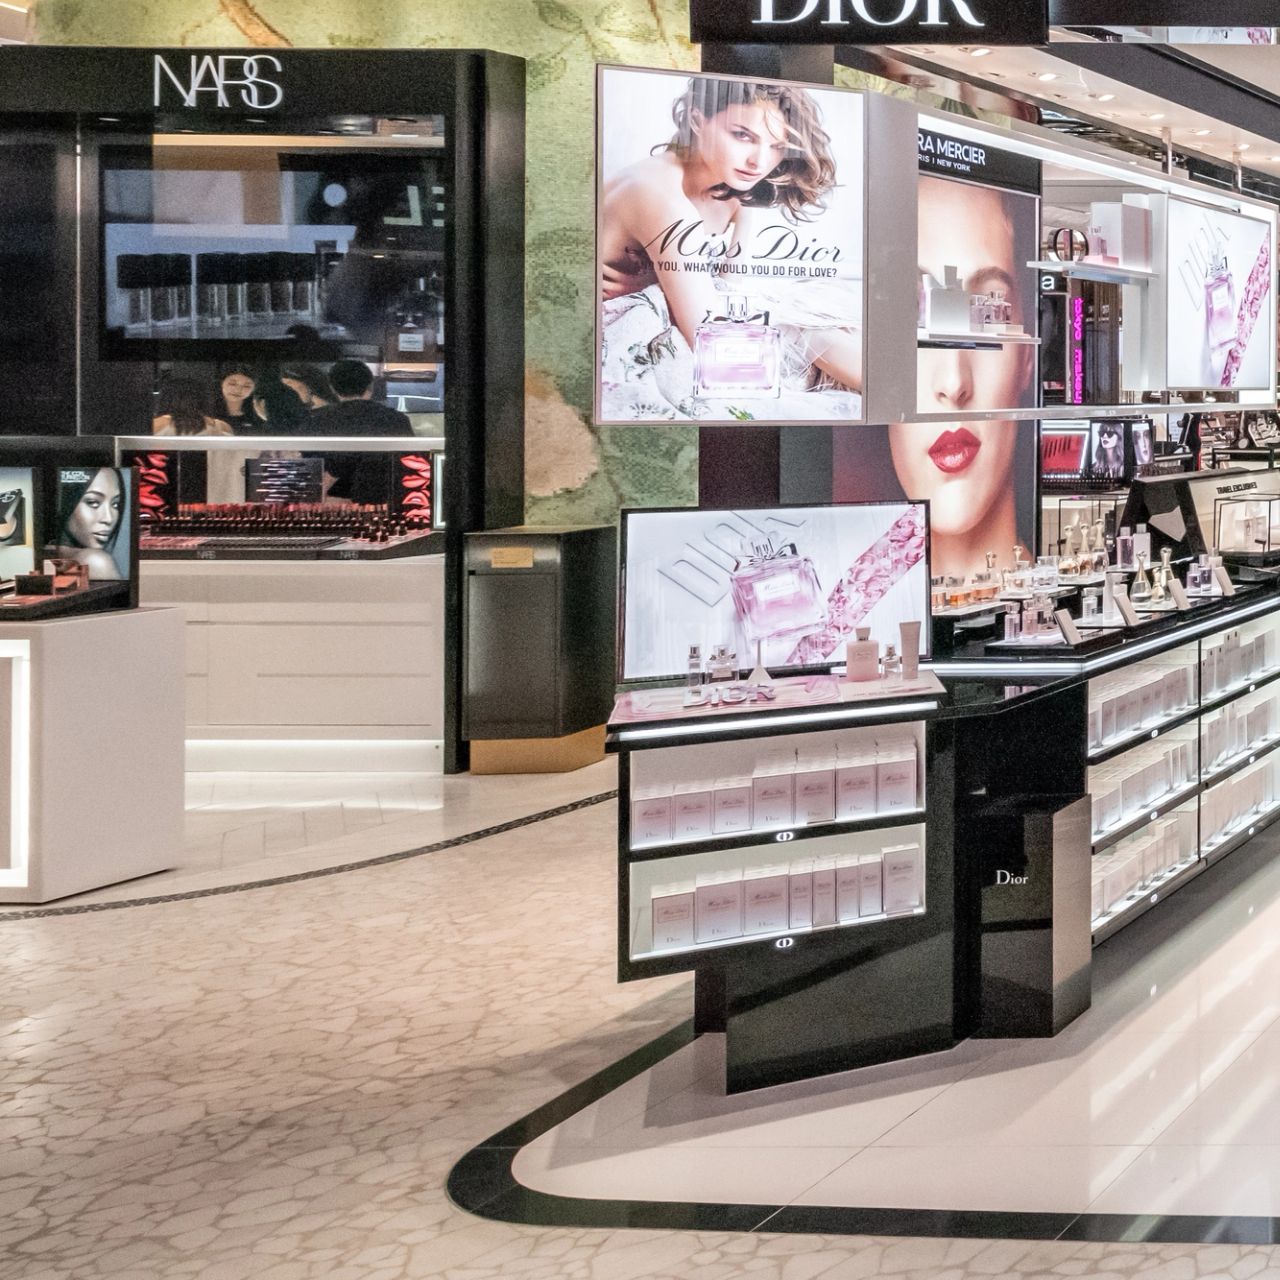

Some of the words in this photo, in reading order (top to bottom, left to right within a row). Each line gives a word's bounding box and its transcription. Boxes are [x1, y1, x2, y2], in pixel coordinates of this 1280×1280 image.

[153, 54, 282, 109] NARS
[937, 138, 986, 166] MERCIER
[937, 159, 952, 167] NEW
[953, 163, 971, 172] YORK
[644, 219, 743, 258] Miss
[752, 225, 843, 263] Dior
[684, 262, 713, 273] WHAT
[713, 263, 748, 275] WOULD
[751, 265, 770, 275] YOU
[772, 265, 785, 276] DO
[788, 266, 807, 277] FOR
[808, 267, 837, 278] LOVE?
[996, 869, 1029, 885] Dior
